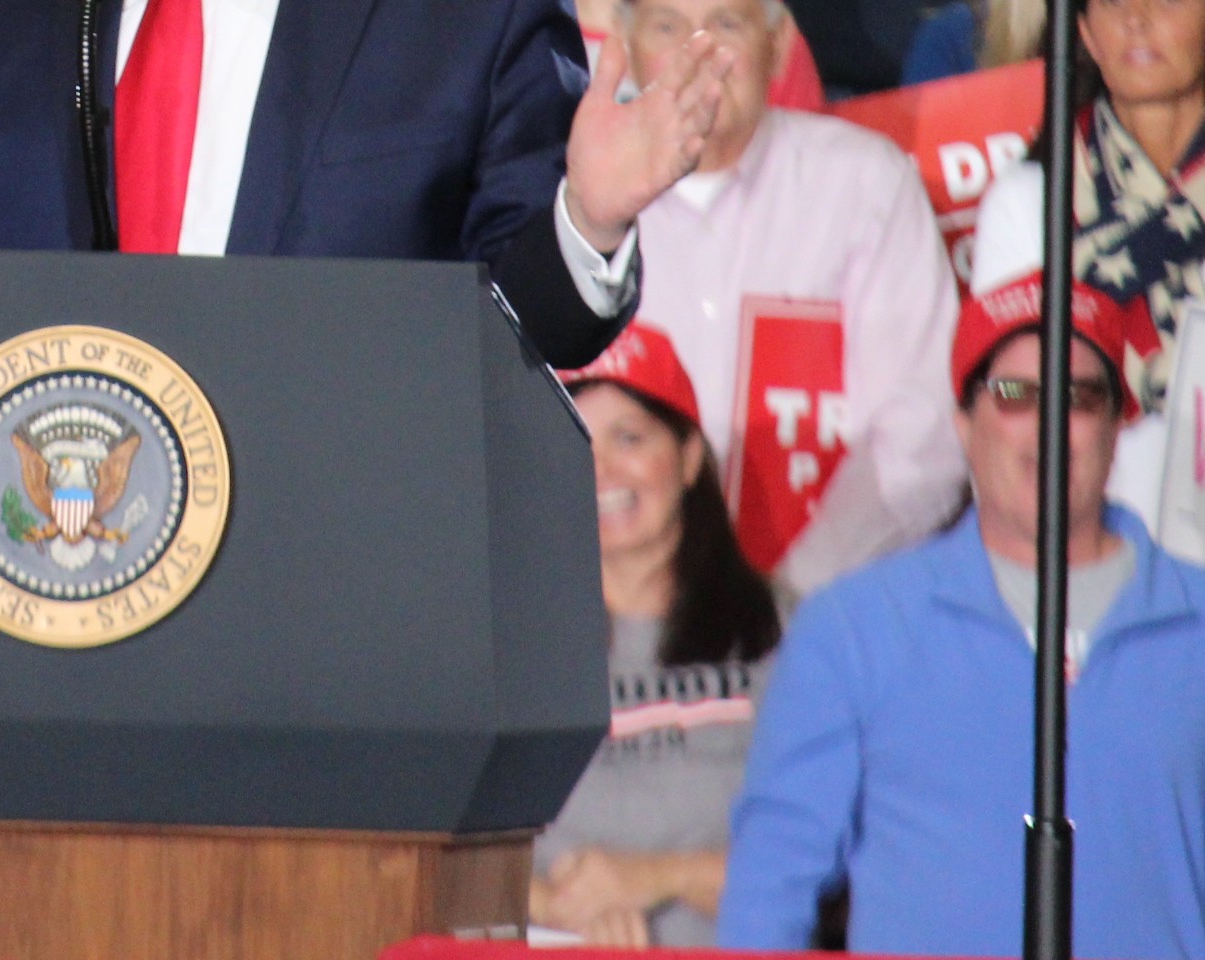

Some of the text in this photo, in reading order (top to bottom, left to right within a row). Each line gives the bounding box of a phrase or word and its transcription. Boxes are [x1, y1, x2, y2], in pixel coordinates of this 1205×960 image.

[80, 342, 110, 362] OF
[115, 349, 153, 380] THE
[158, 378, 219, 508] UNITED
[96, 534, 202, 630] STATES
